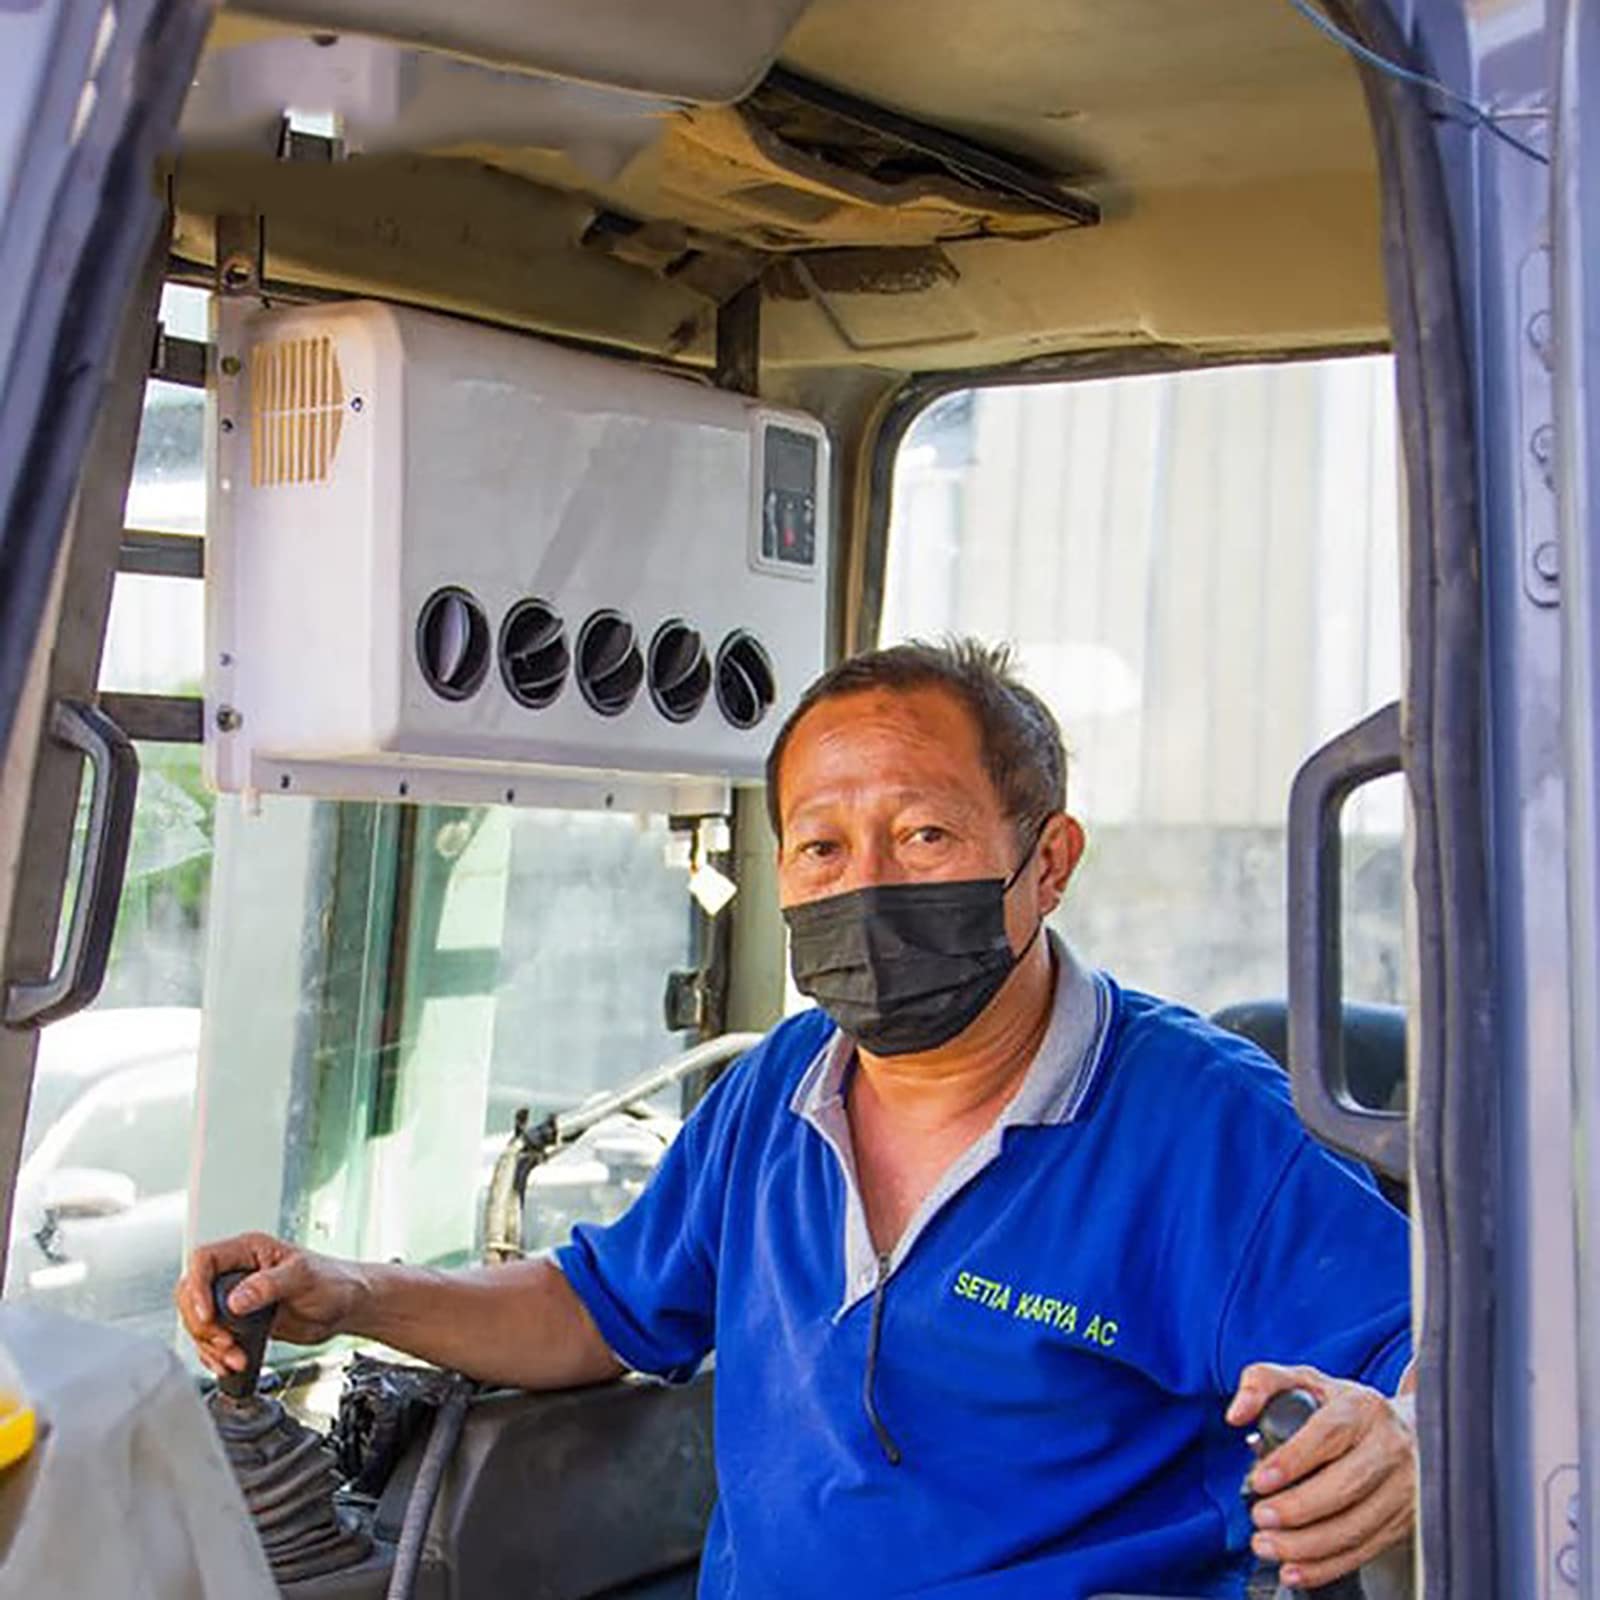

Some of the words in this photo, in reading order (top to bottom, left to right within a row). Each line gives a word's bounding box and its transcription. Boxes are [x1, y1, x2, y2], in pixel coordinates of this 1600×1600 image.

[954, 1271, 1012, 1311] SETIA
[1014, 1292, 1078, 1334] KARYA
[1082, 1314, 1118, 1346] AC
